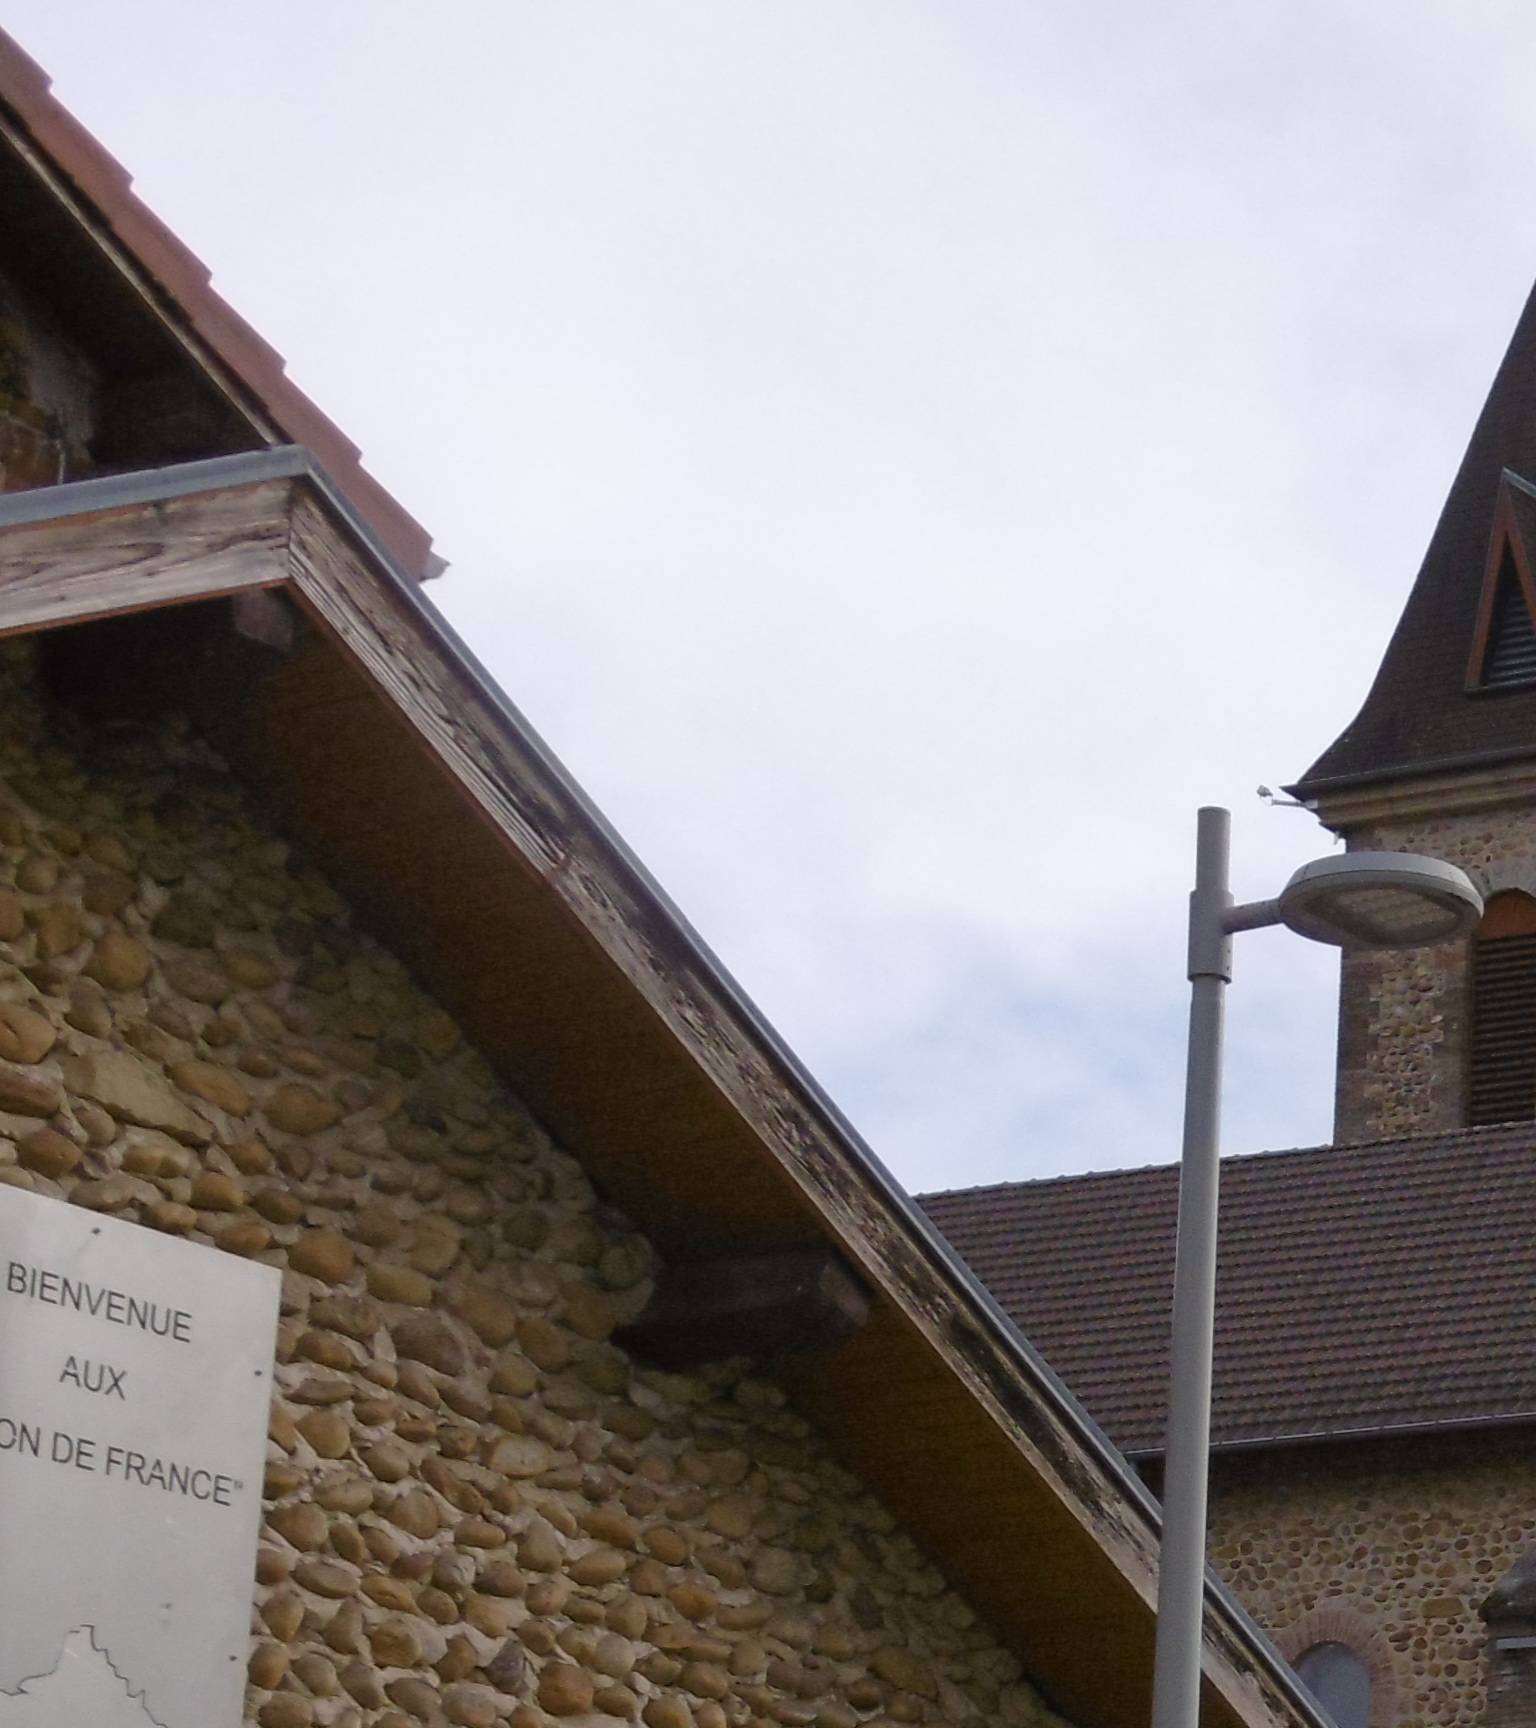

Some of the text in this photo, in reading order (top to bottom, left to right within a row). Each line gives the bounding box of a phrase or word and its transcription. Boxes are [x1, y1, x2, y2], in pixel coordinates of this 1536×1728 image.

[7, 1262, 192, 1343] BIENVENUE
[59, 1356, 127, 1400] AUX
[51, 1432, 96, 1471] DE
